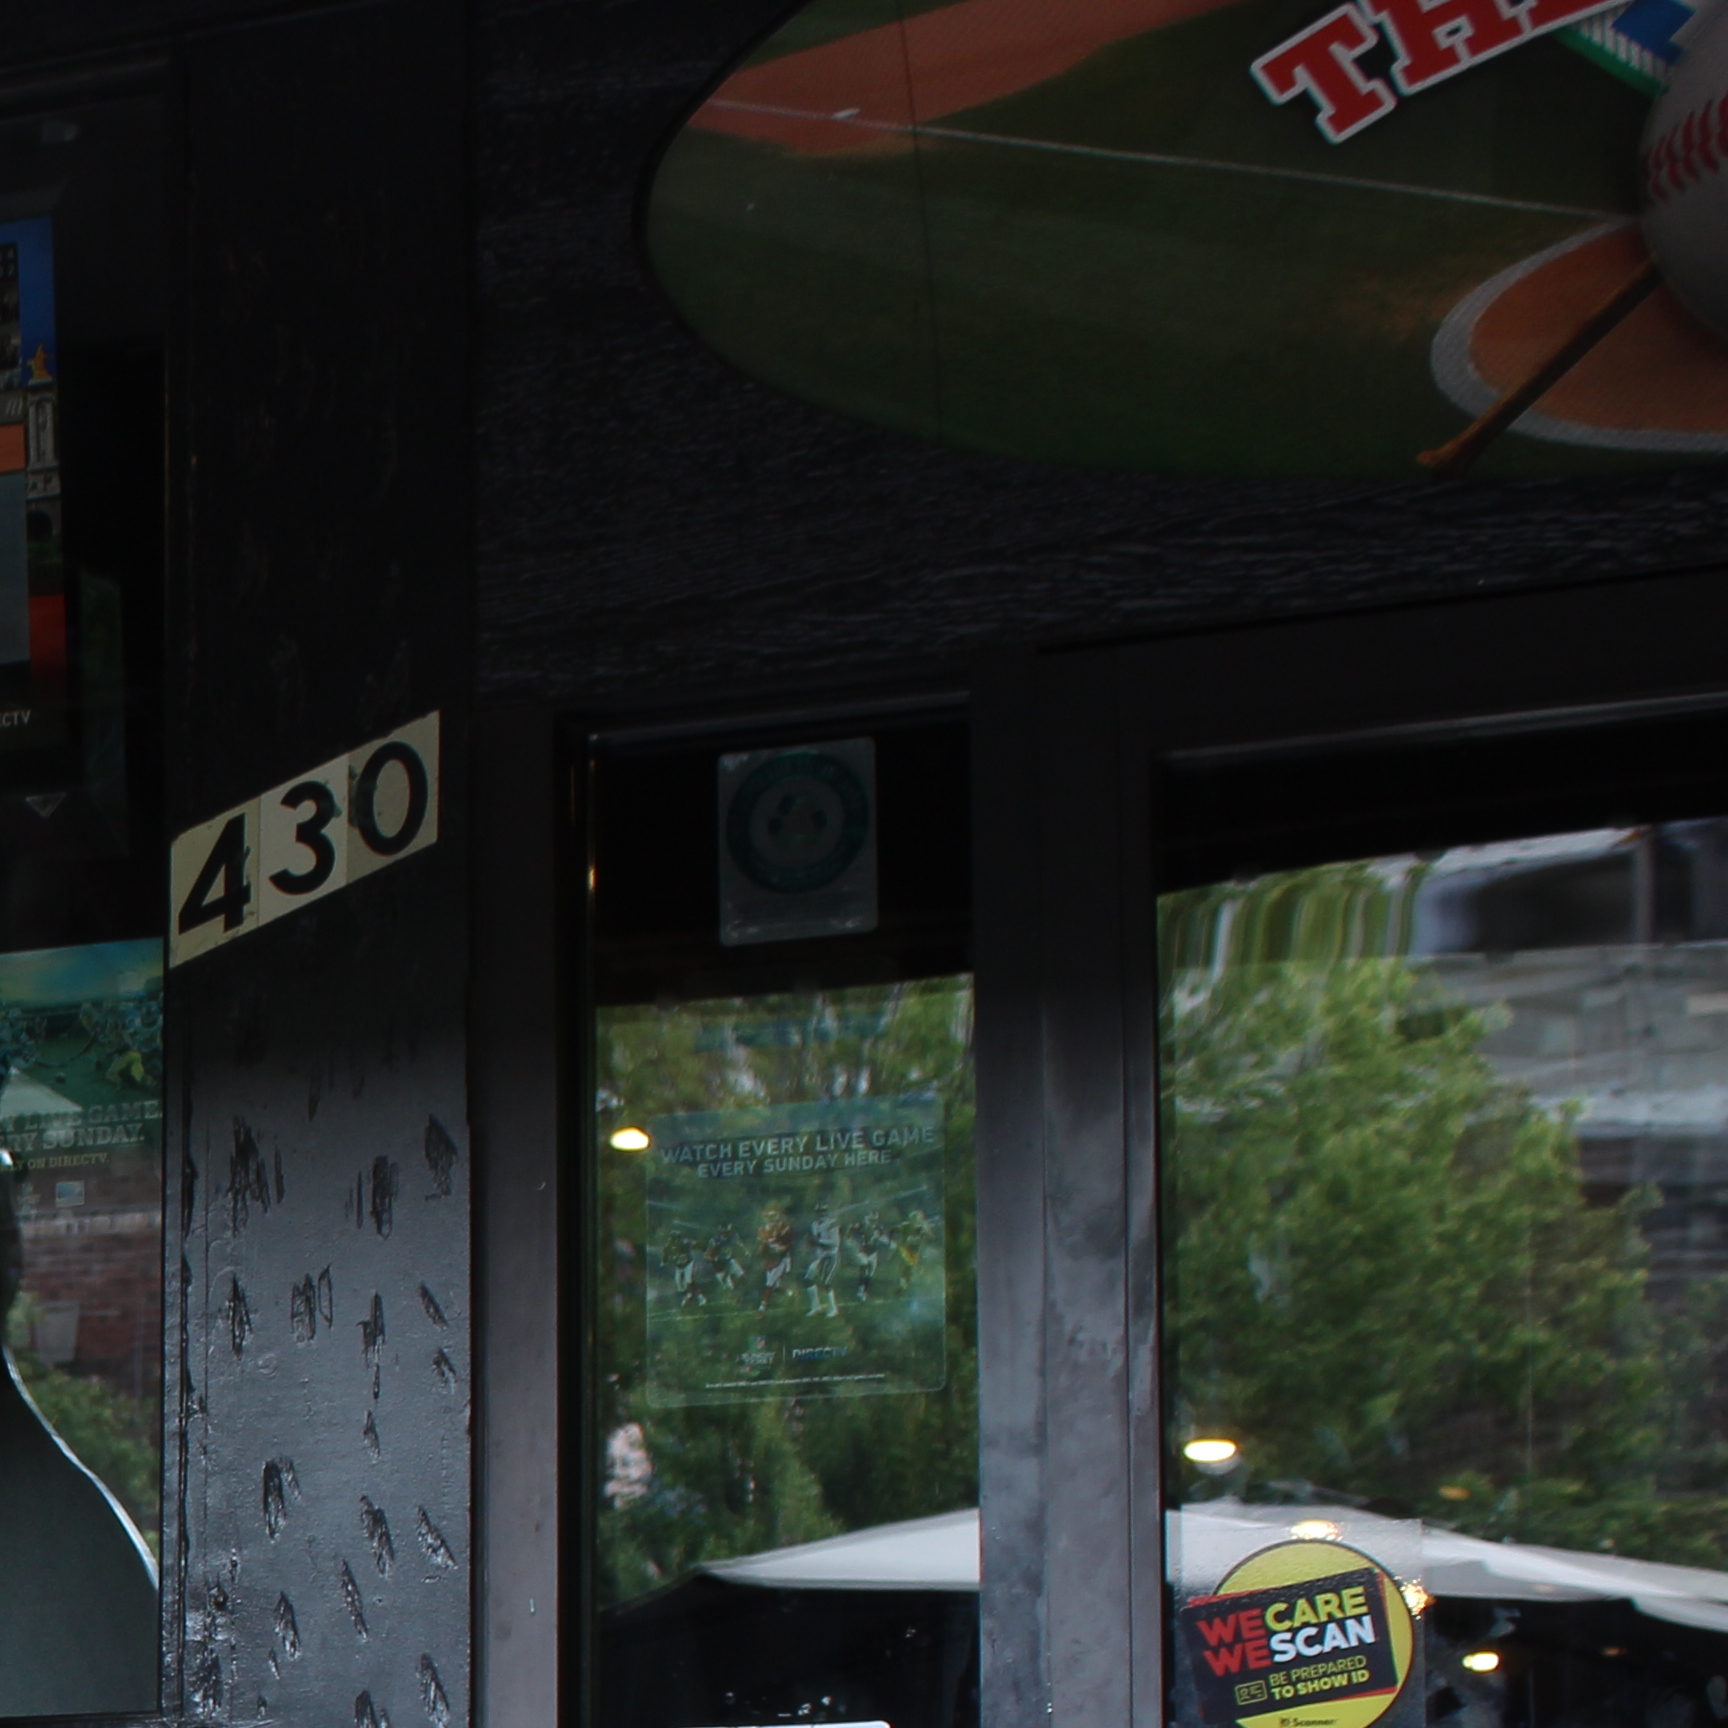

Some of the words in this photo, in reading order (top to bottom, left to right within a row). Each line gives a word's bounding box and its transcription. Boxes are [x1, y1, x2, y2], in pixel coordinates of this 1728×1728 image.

[1249, 0, 1629, 145] TH
[177, 740, 431, 936] 430
[662, 1144, 733, 1165] WATCH
[737, 1136, 807, 1159] EVERY
[816, 1131, 865, 1152] LIVE
[872, 1126, 935, 1147] GAME
[697, 1160, 757, 1178] EVERY
[763, 1154, 838, 1174] SUNDAY
[845, 1149, 891, 1166] HERE
[1196, 1607, 1266, 1647] WE
[1265, 1586, 1369, 1632] CARE
[1202, 1637, 1273, 1677] WE
[1269, 1615, 1376, 1663] SCAN
[1269, 1670, 1288, 1687] BE
[1291, 1655, 1368, 1682] PREPARED
[1271, 1685, 1295, 1700] TO
[1297, 1673, 1349, 1695] SHOW
[1351, 1669, 1371, 1684] ID
